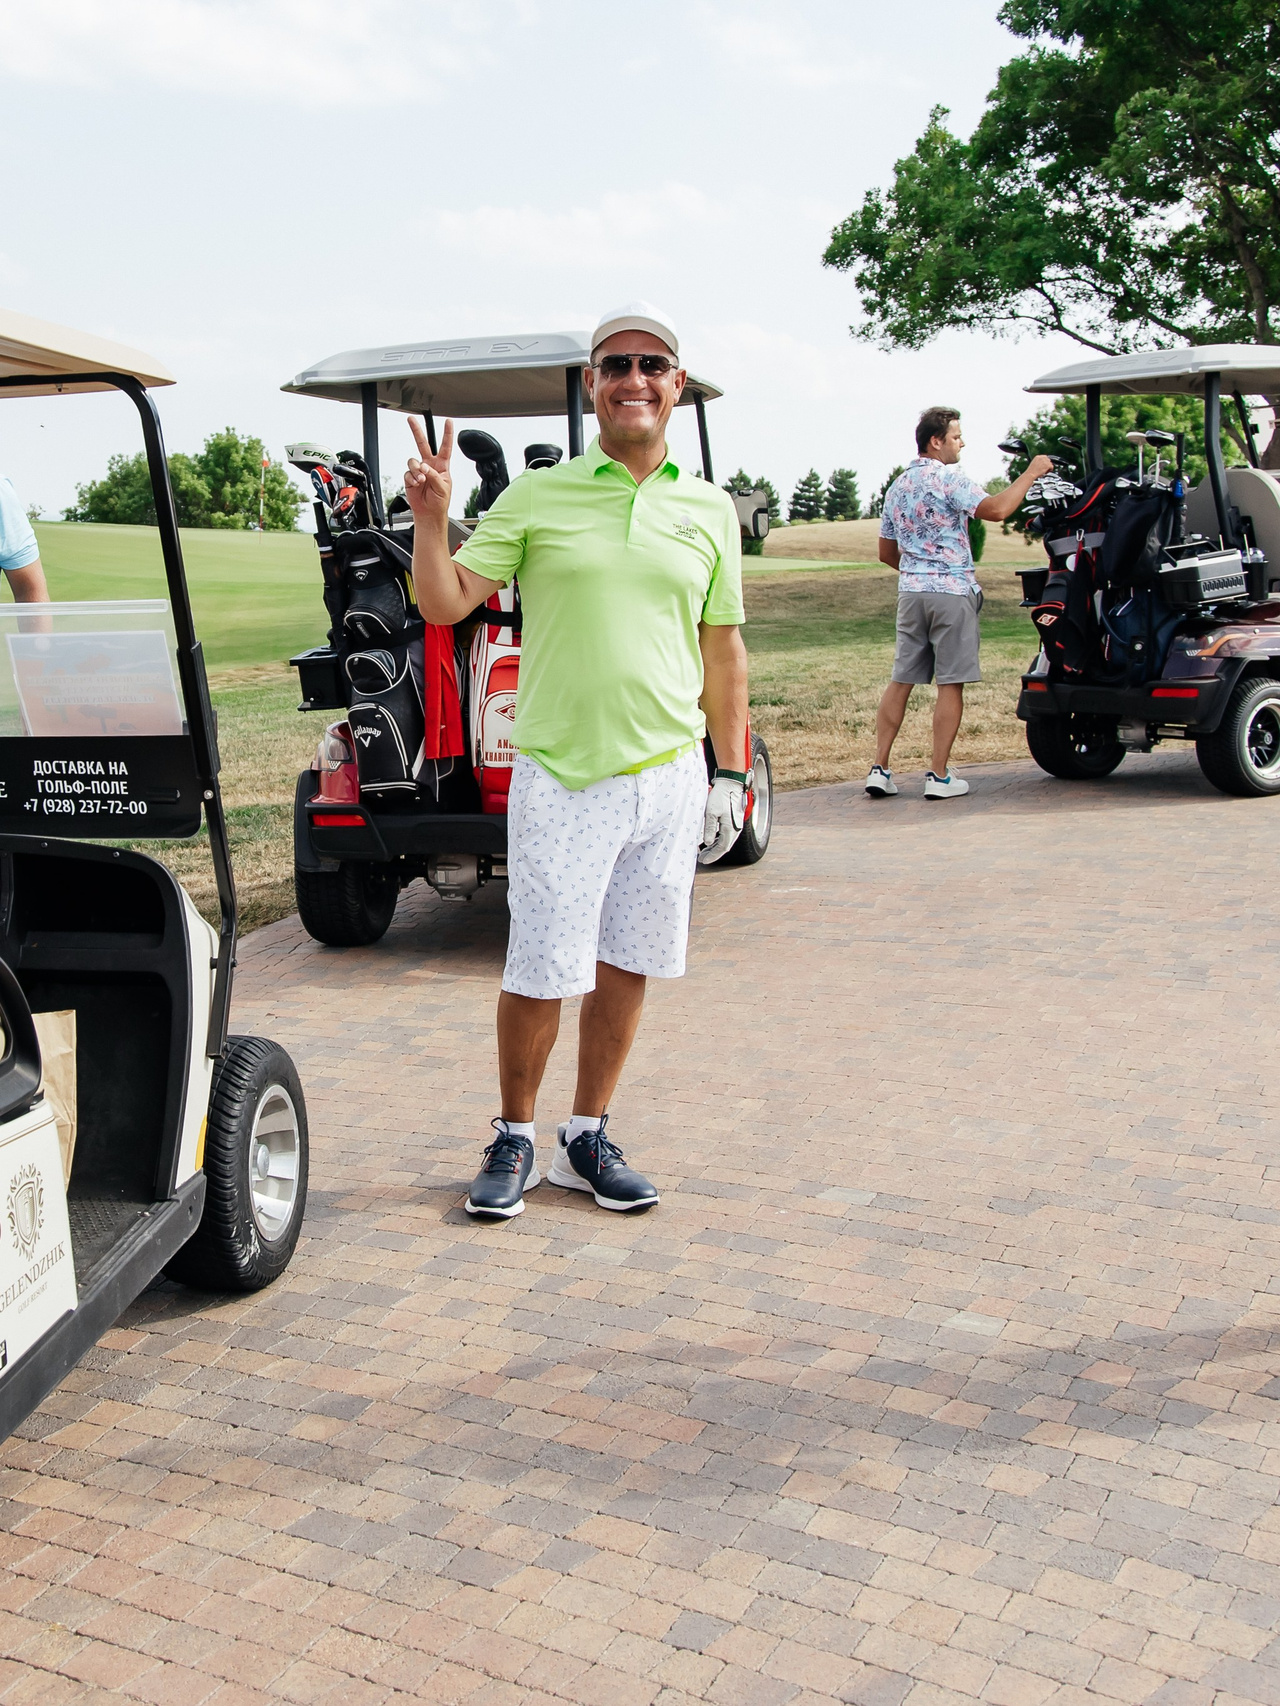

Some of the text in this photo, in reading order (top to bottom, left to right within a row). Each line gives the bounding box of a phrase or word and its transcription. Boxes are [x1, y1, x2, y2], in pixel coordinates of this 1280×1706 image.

[302, 449, 332, 461] EPIC
[485, 751, 514, 762] KHARITO
[33, 760, 128, 776] ДОСТАВКА НА
[37, 779, 128, 795] ГОЛЬФ-ПОЛЕ
[23, 799, 147, 815] +7 (928) 237-72-00
